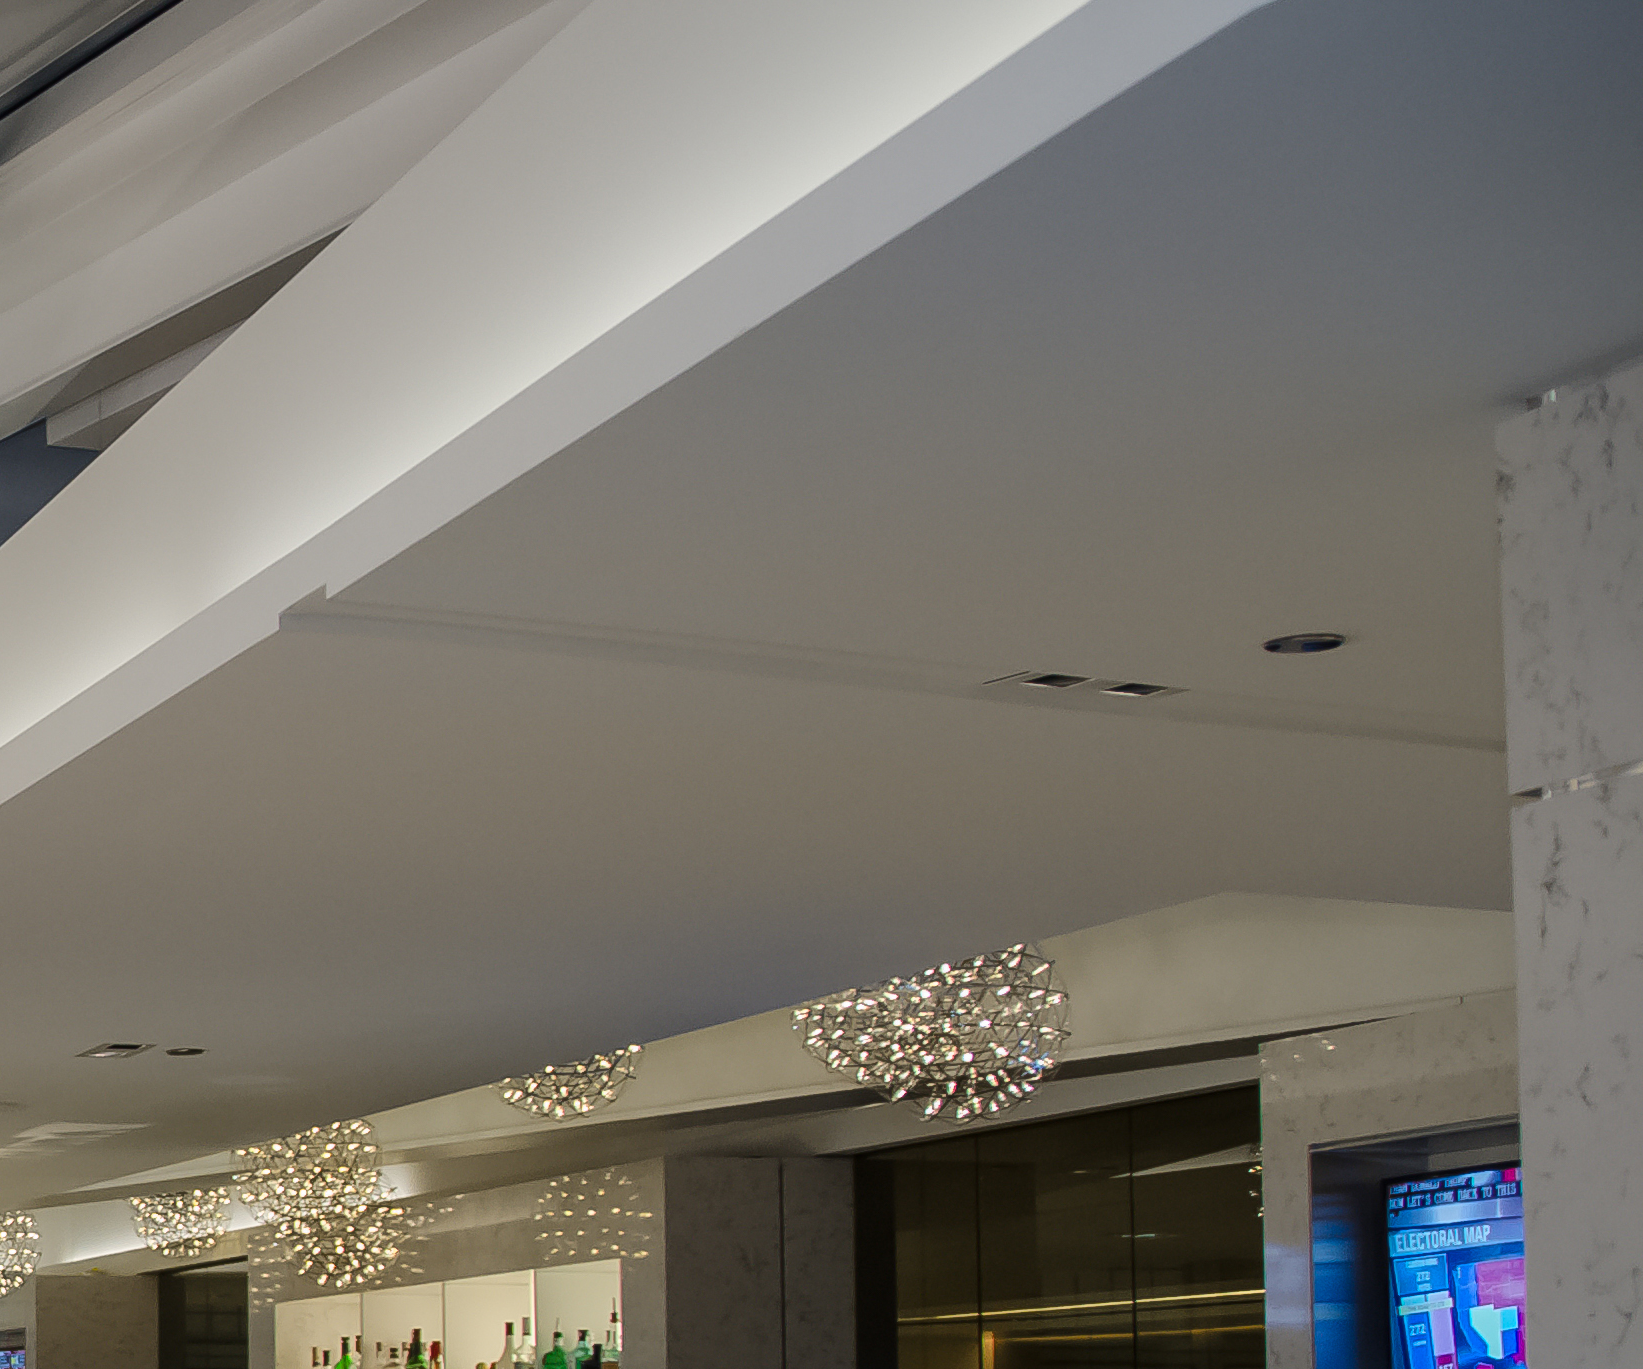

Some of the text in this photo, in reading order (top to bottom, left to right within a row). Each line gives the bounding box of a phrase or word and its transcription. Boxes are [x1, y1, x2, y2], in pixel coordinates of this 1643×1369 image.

[1481, 1186, 1493, 1198] TO
[1496, 1183, 1517, 1196] THIS
[1395, 1224, 1491, 1252] ELECTORAL MAP
